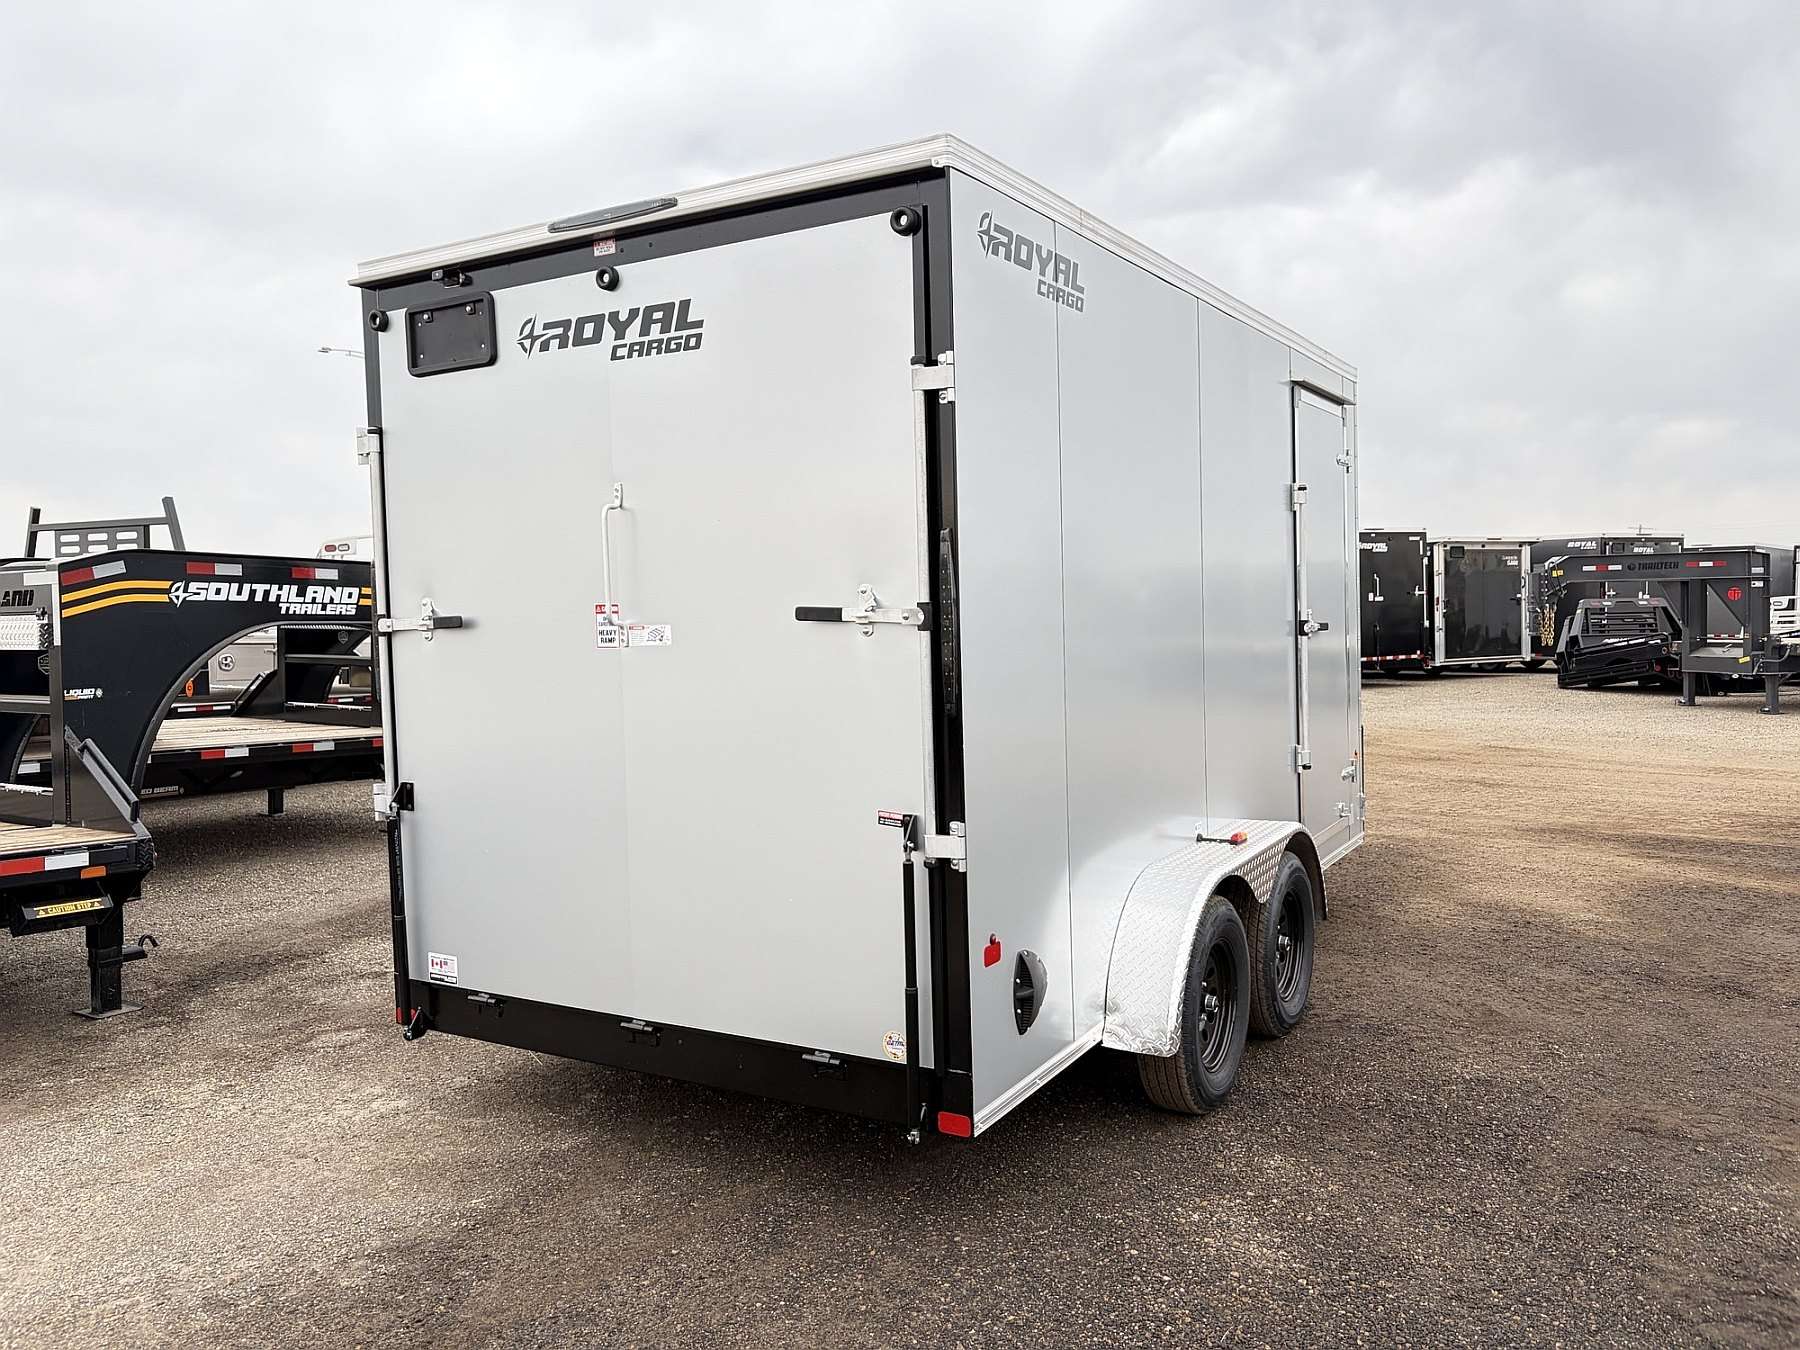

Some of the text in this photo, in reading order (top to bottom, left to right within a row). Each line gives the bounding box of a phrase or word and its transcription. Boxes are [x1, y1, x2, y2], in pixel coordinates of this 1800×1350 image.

[991, 222, 1085, 295] ROYAL
[1037, 278, 1085, 313] CARGO
[539, 298, 705, 353] ROYAL
[610, 332, 704, 362] CARGO
[187, 581, 360, 604] SOUTHLAND
[278, 602, 357, 616] TRAILERS
[598, 629, 617, 637] HEAVY
[47, 903, 76, 914] CAUTION
